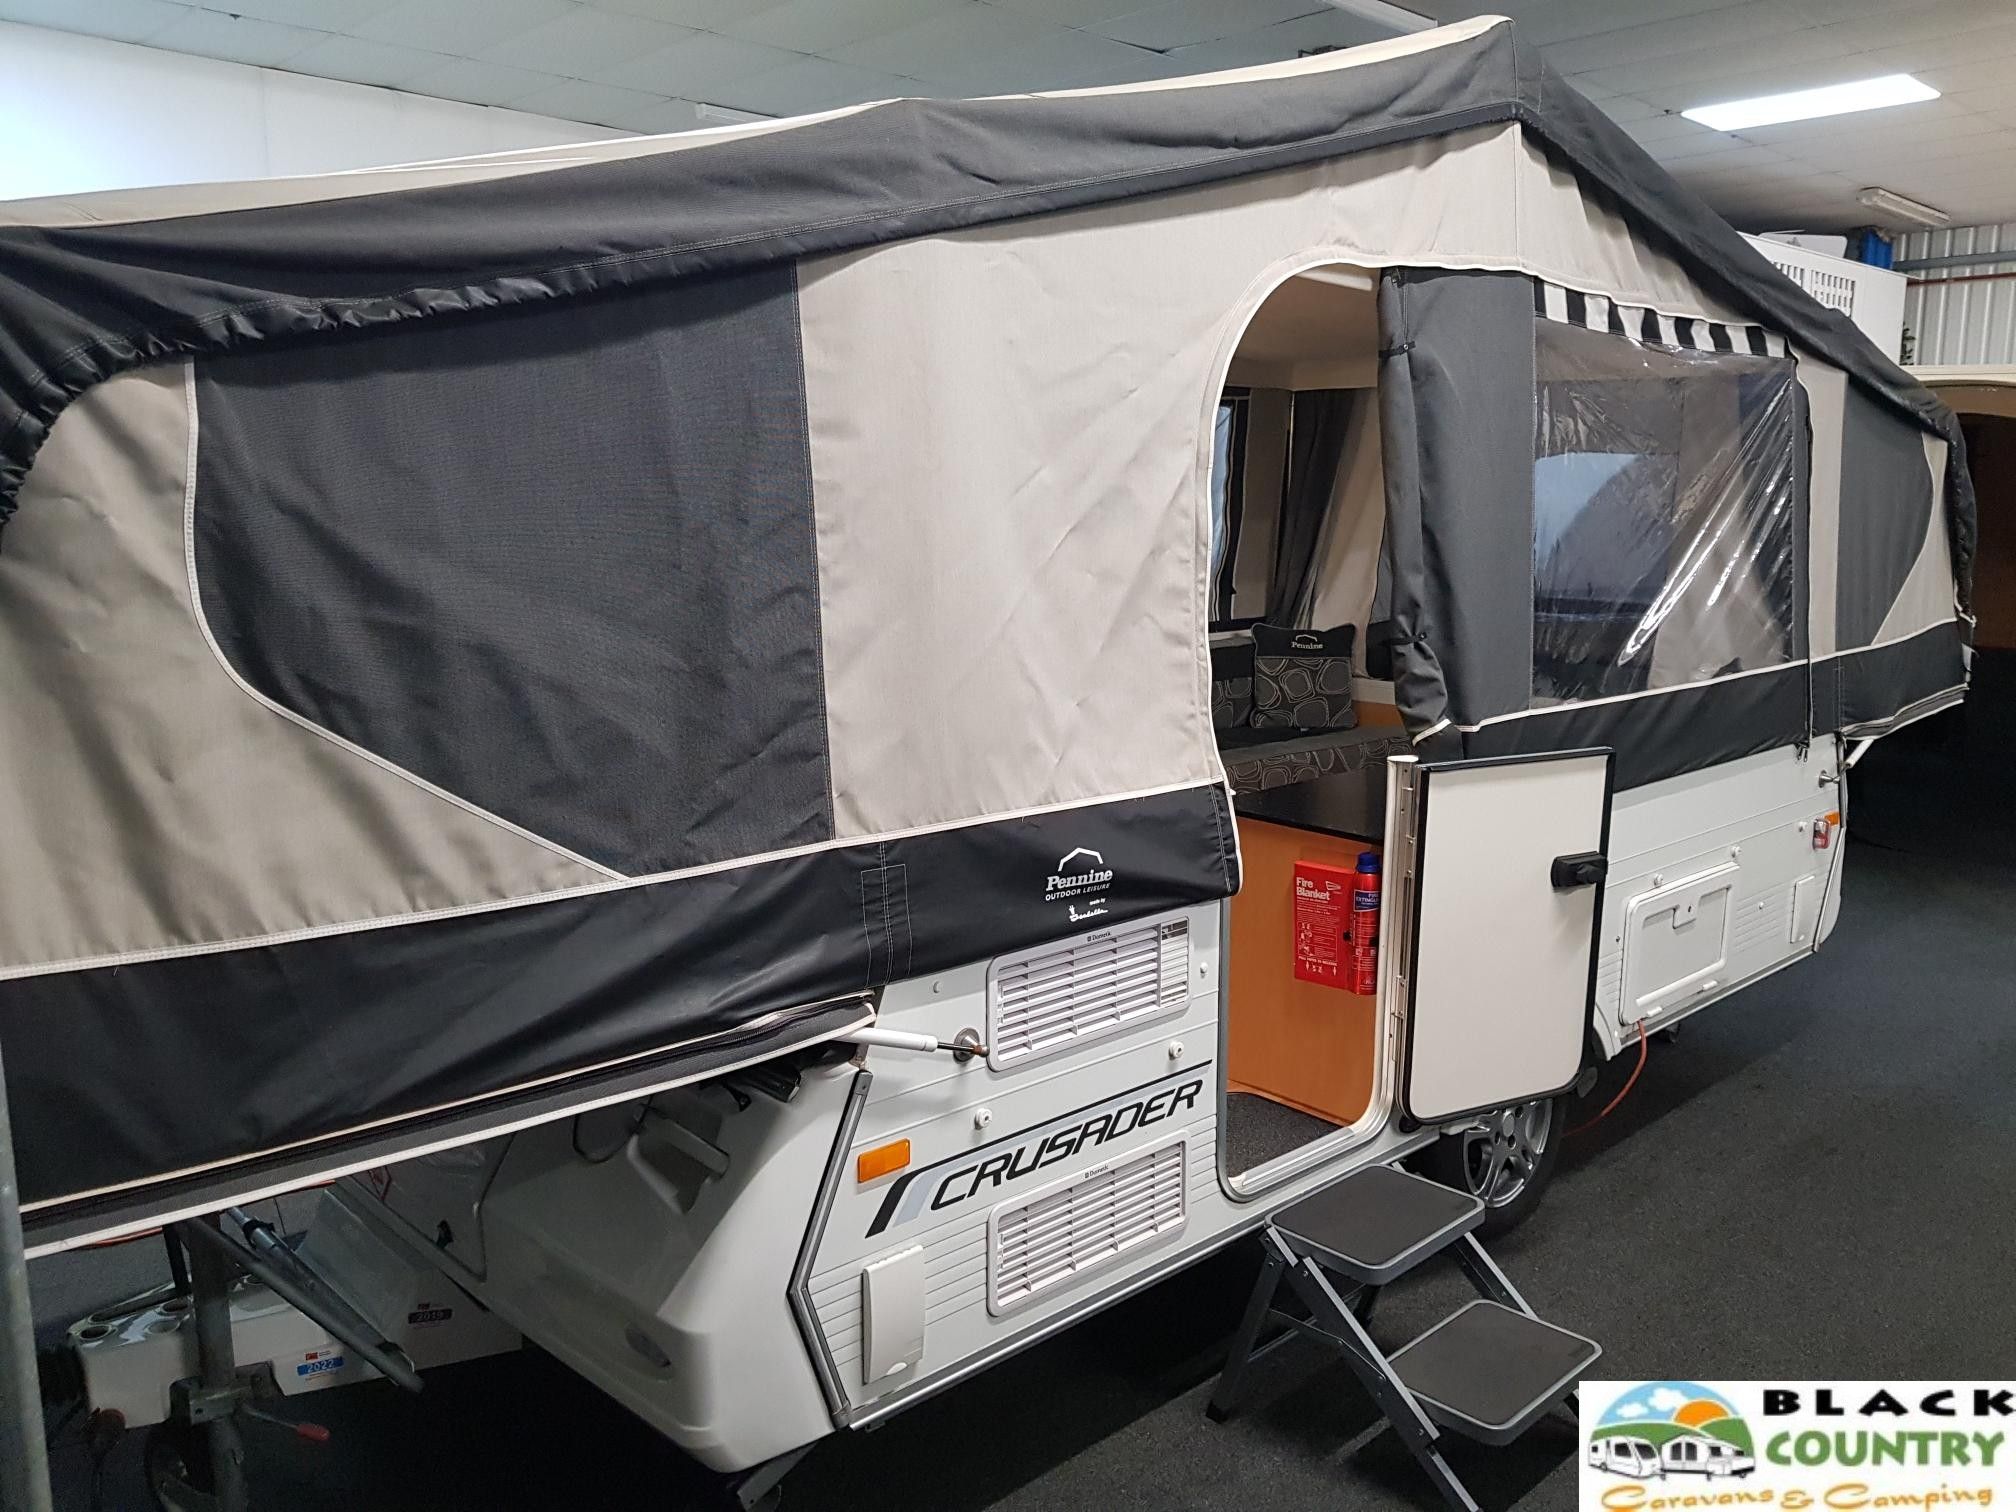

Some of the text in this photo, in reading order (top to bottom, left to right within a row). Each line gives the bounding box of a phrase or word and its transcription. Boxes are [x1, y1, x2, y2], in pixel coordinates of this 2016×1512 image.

[1291, 641, 1323, 649] Pennine
[1046, 869, 1113, 891] Pennine
[1296, 877, 1314, 889] Fire
[1045, 883, 1110, 901] OUTDOOR LEISURE
[1296, 886, 1330, 901] Blanket
[930, 1079, 1204, 1211] CRUSADER
[307, 1358, 335, 1374] 2022
